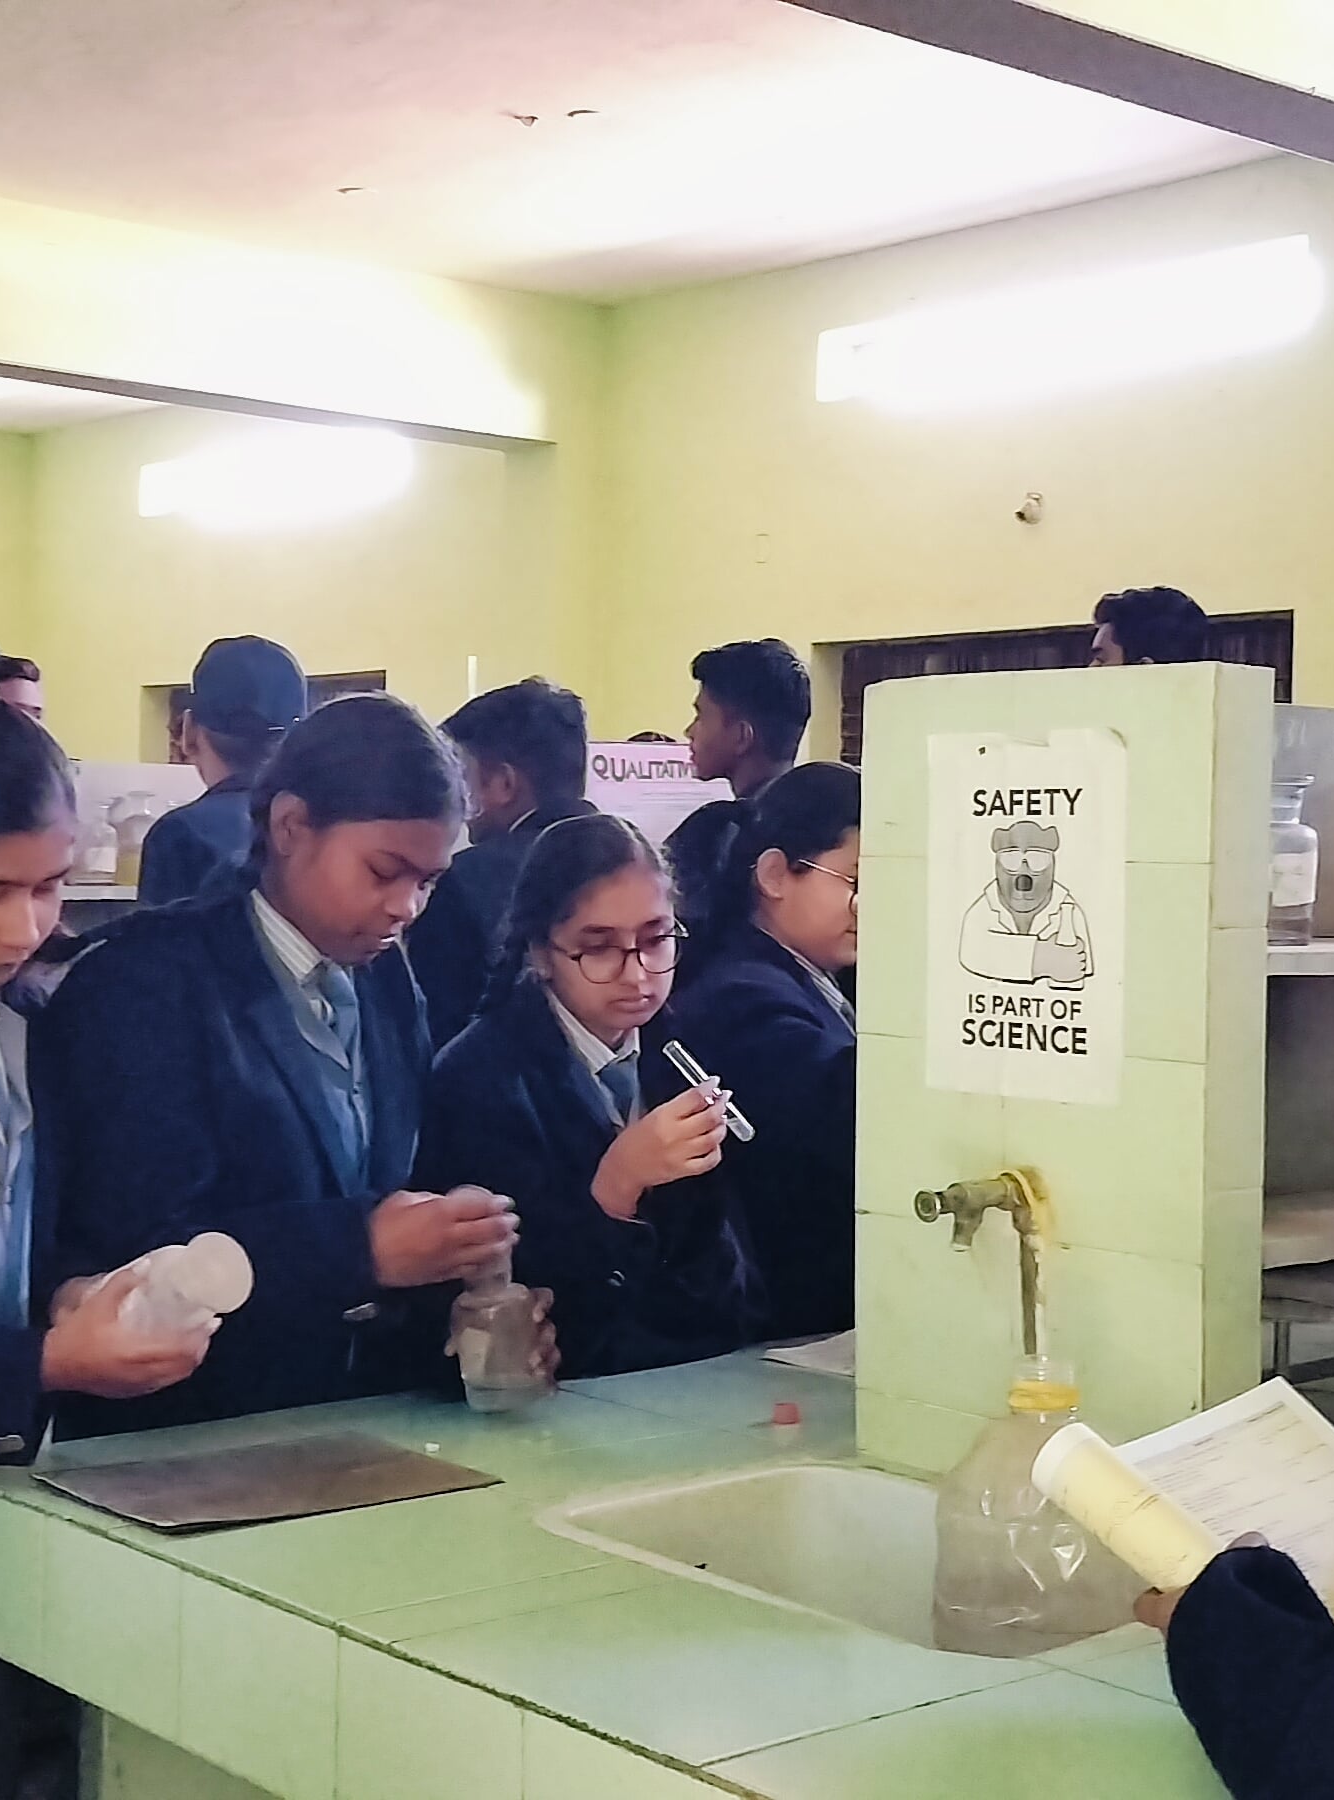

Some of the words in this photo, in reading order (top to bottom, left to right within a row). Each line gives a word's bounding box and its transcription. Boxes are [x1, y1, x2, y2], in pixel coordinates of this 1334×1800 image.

[972, 788, 1083, 817] SAFETY
[968, 993, 986, 1014] IS
[992, 995, 1045, 1018] PART
[1050, 999, 1082, 1021] OF
[961, 1018, 1088, 1055] SCIENCE
